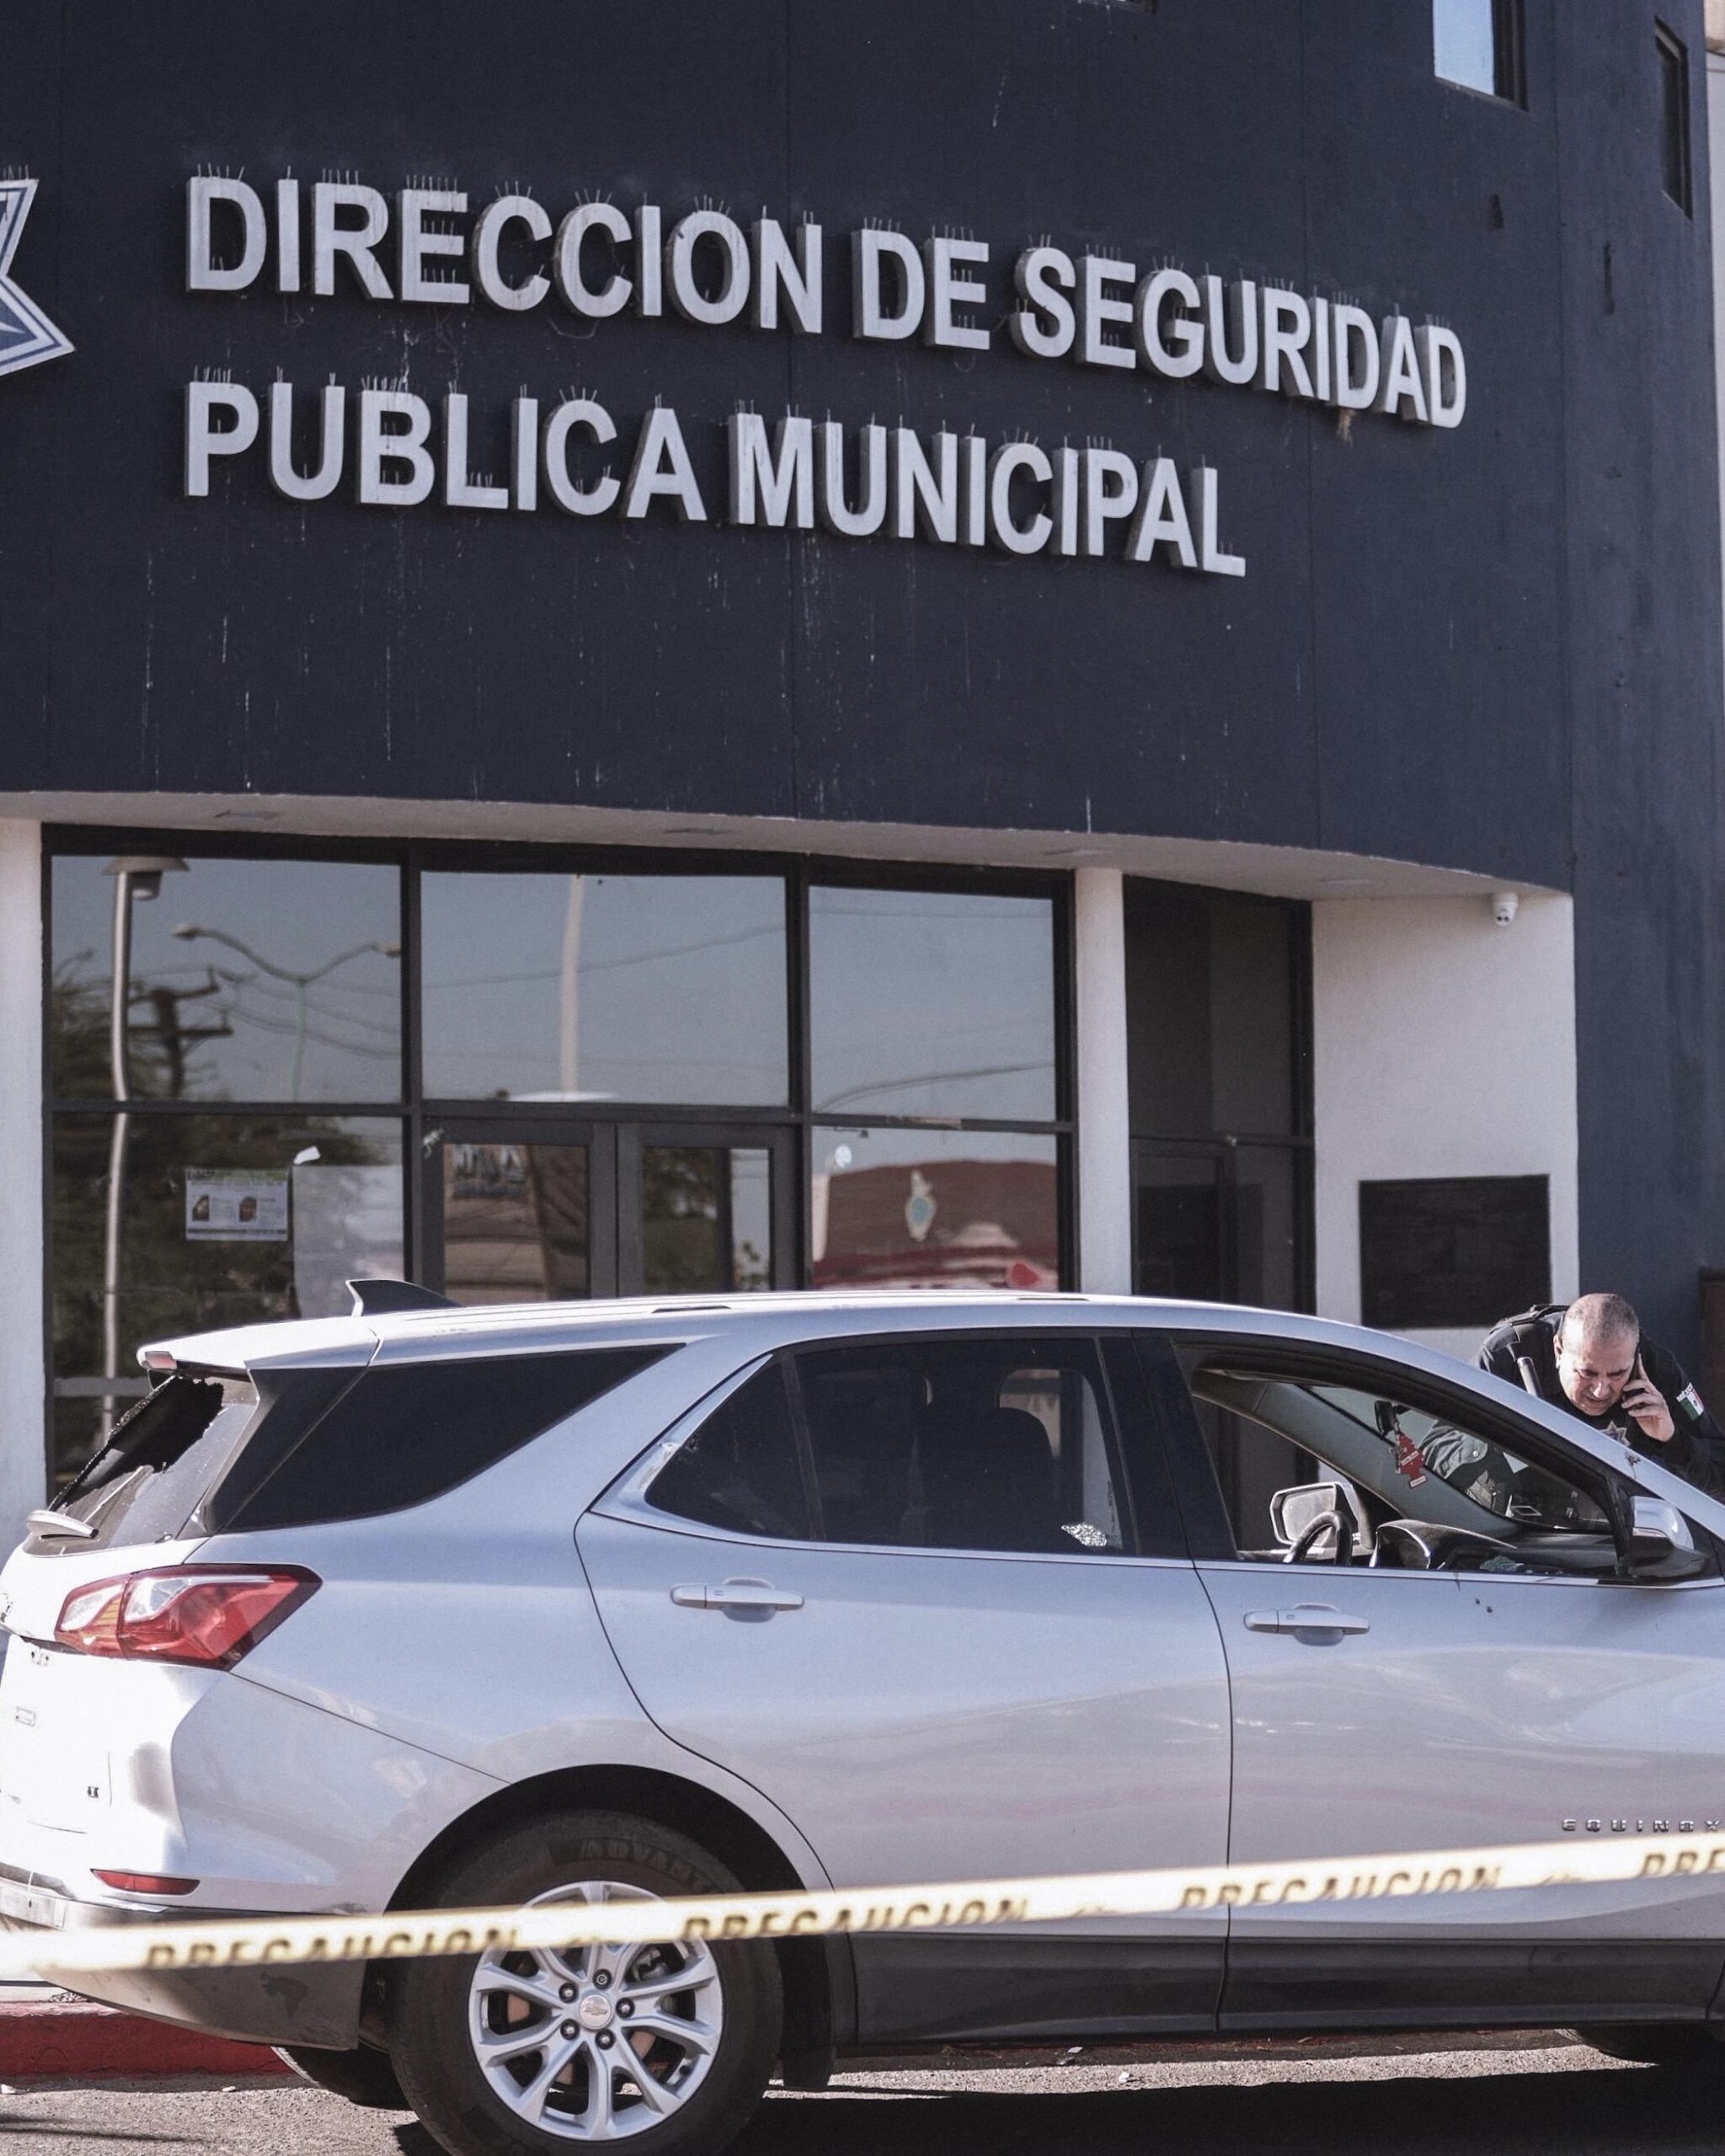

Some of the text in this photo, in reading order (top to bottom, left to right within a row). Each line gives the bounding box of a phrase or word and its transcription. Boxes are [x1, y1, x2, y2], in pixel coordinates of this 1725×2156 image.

[186, 176, 1466, 430] DIRECCION DE SEGURIDAD
[184, 381, 1247, 579] PUBLICA MUNICIPAL
[1562, 1818, 1721, 1833] EQUINOX
